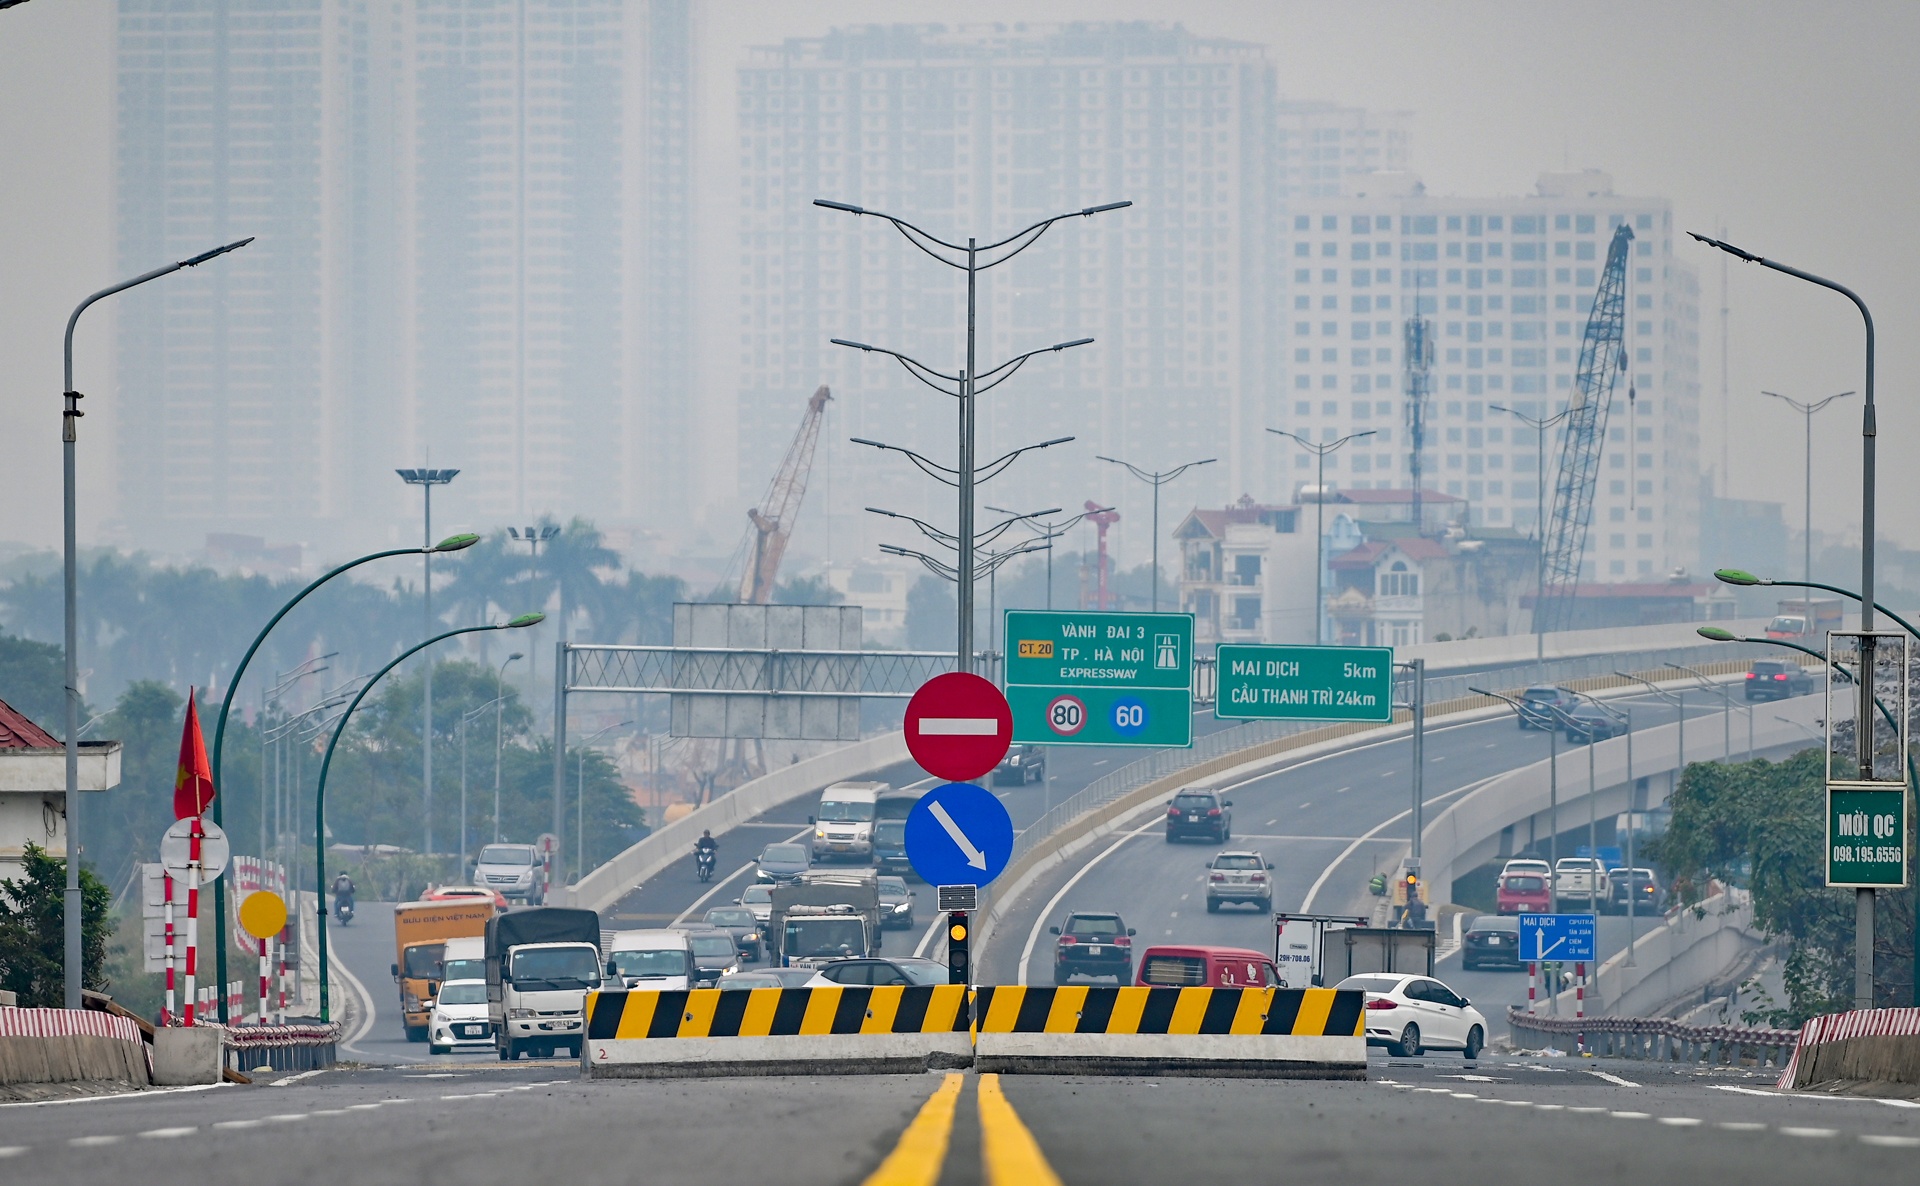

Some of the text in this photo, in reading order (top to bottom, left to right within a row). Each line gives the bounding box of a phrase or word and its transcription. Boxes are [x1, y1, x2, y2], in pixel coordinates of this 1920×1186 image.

[1062, 622, 1145, 639] VÀNH ĐAI 3
[1019, 643, 1052, 655] CT.20
[1094, 646, 1114, 662] HÀ
[1121, 648, 1145, 664] NỘI
[1060, 667, 1138, 679] EXPRESSWAY
[1231, 660, 1377, 679] MAI DỊCH 5km
[1231, 682, 1376, 706] CẦU THANH TRÌ 24km
[1052, 704, 1080, 726] 80
[1116, 705, 1143, 727] 60
[1838, 810, 1895, 839] MỜI QC
[1833, 845, 1902, 863] 098.195.6556
[446, 913, 464, 921] VIỆT
[1523, 917, 1556, 928] MAI DỊCH
[599, 1048, 609, 1060] 2
